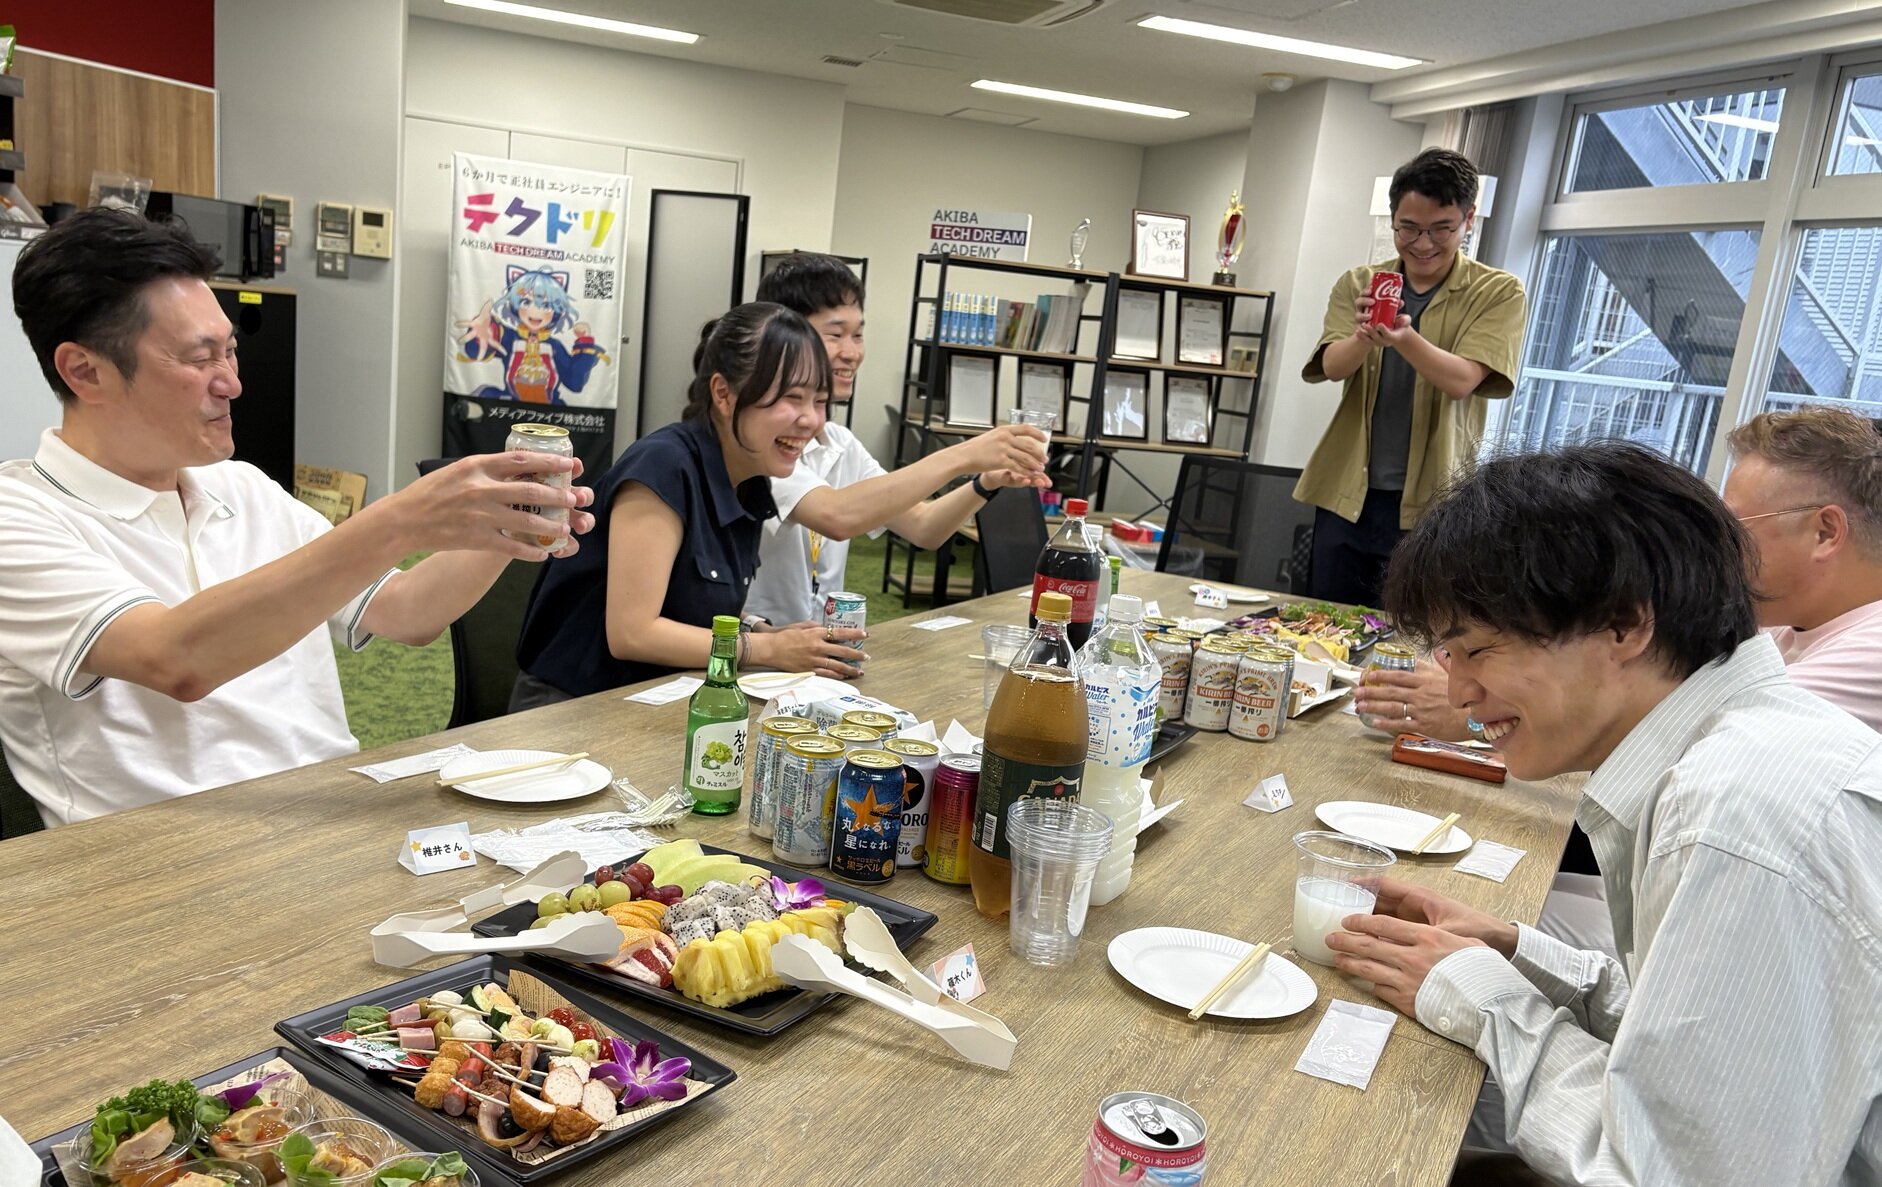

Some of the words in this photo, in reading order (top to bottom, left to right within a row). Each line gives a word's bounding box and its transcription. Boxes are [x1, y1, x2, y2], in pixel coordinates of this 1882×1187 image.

[463, 193, 616, 248] テクドリ
[934, 209, 978, 224] AKIBA
[933, 225, 971, 240] TECH
[972, 228, 1025, 245] DREAM
[460, 238, 494, 251] AKIBA
[497, 243, 524, 255] TECH
[525, 247, 564, 261] DREAM
[565, 253, 616, 265] ACADEMY
[929, 242, 1000, 259] ACADEMY
[488, 406, 606, 427] メディアファイブ株式会社
[1199, 687, 1223, 698] KIRIN
[846, 861, 881, 872] 黒ラベル
[1115, 1145, 1154, 1165] HOROYOI
